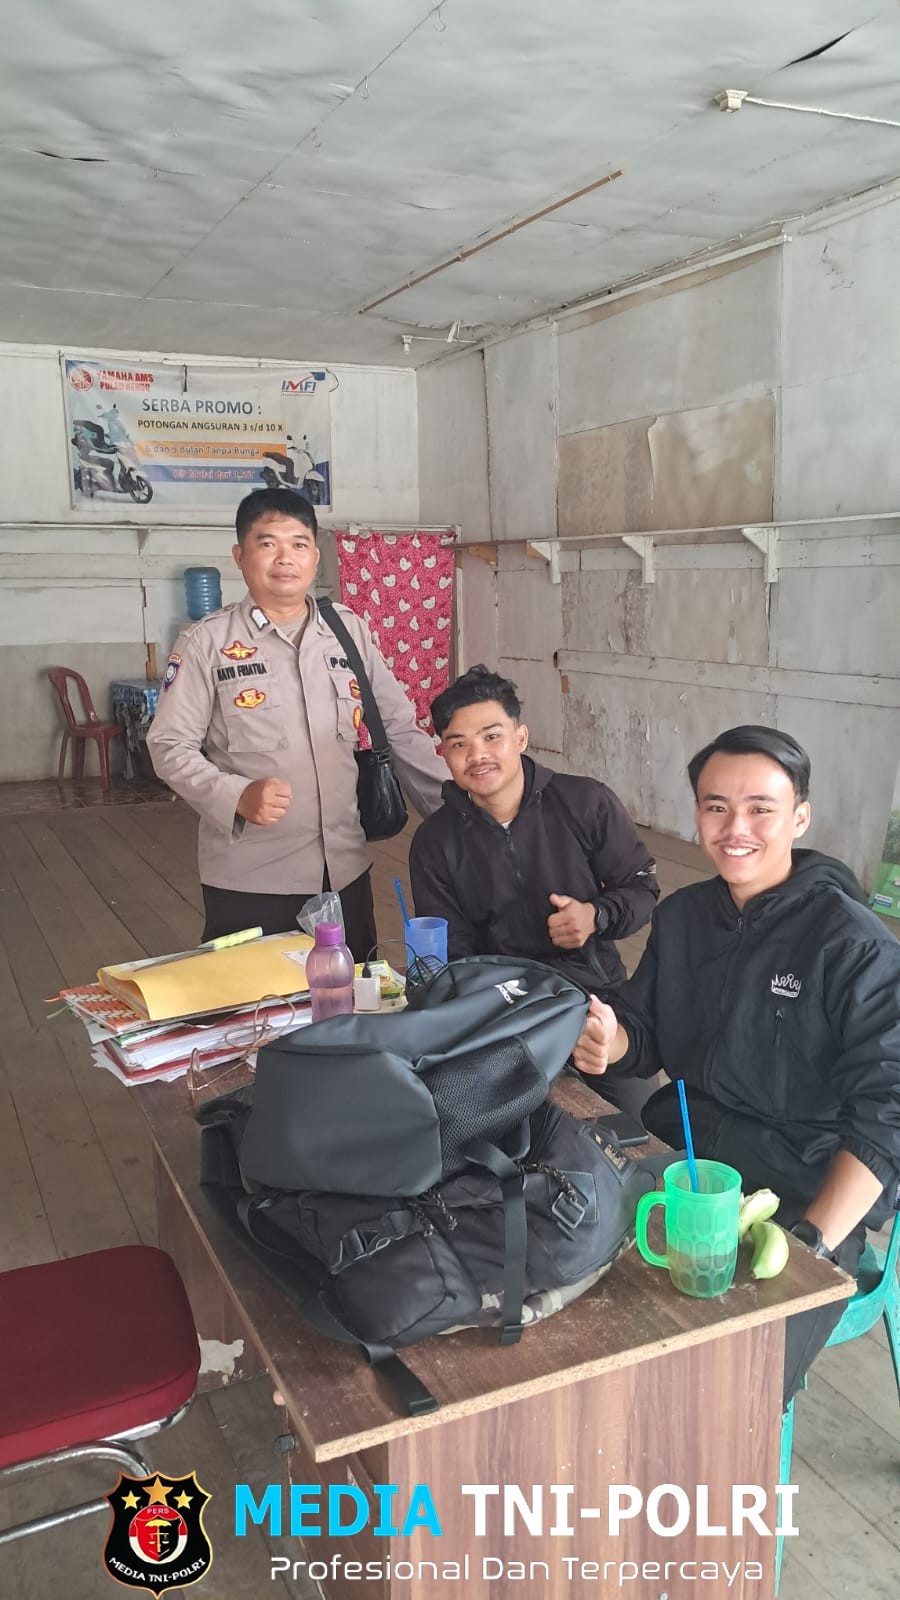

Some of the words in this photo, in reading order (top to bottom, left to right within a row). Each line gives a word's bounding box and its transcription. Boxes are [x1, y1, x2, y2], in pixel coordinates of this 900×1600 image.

[97, 369, 134, 381] YAMAHA
[135, 372, 154, 382] AMS
[142, 398, 191, 413] SERBA
[195, 400, 253, 415] PROMO
[137, 420, 189, 429] POTONGAN
[191, 421, 240, 431] ANGSURAN
[242, 423, 248, 431] 3
[249, 423, 264, 432] s/d
[266, 424, 276, 432] 10
[277, 424, 283, 432] X
[180, 446, 203, 454] Bulan
[207, 446, 232, 456] Tanpa
[234, 447, 260, 456] Bunga
[216, 665, 236, 682] BAYU
